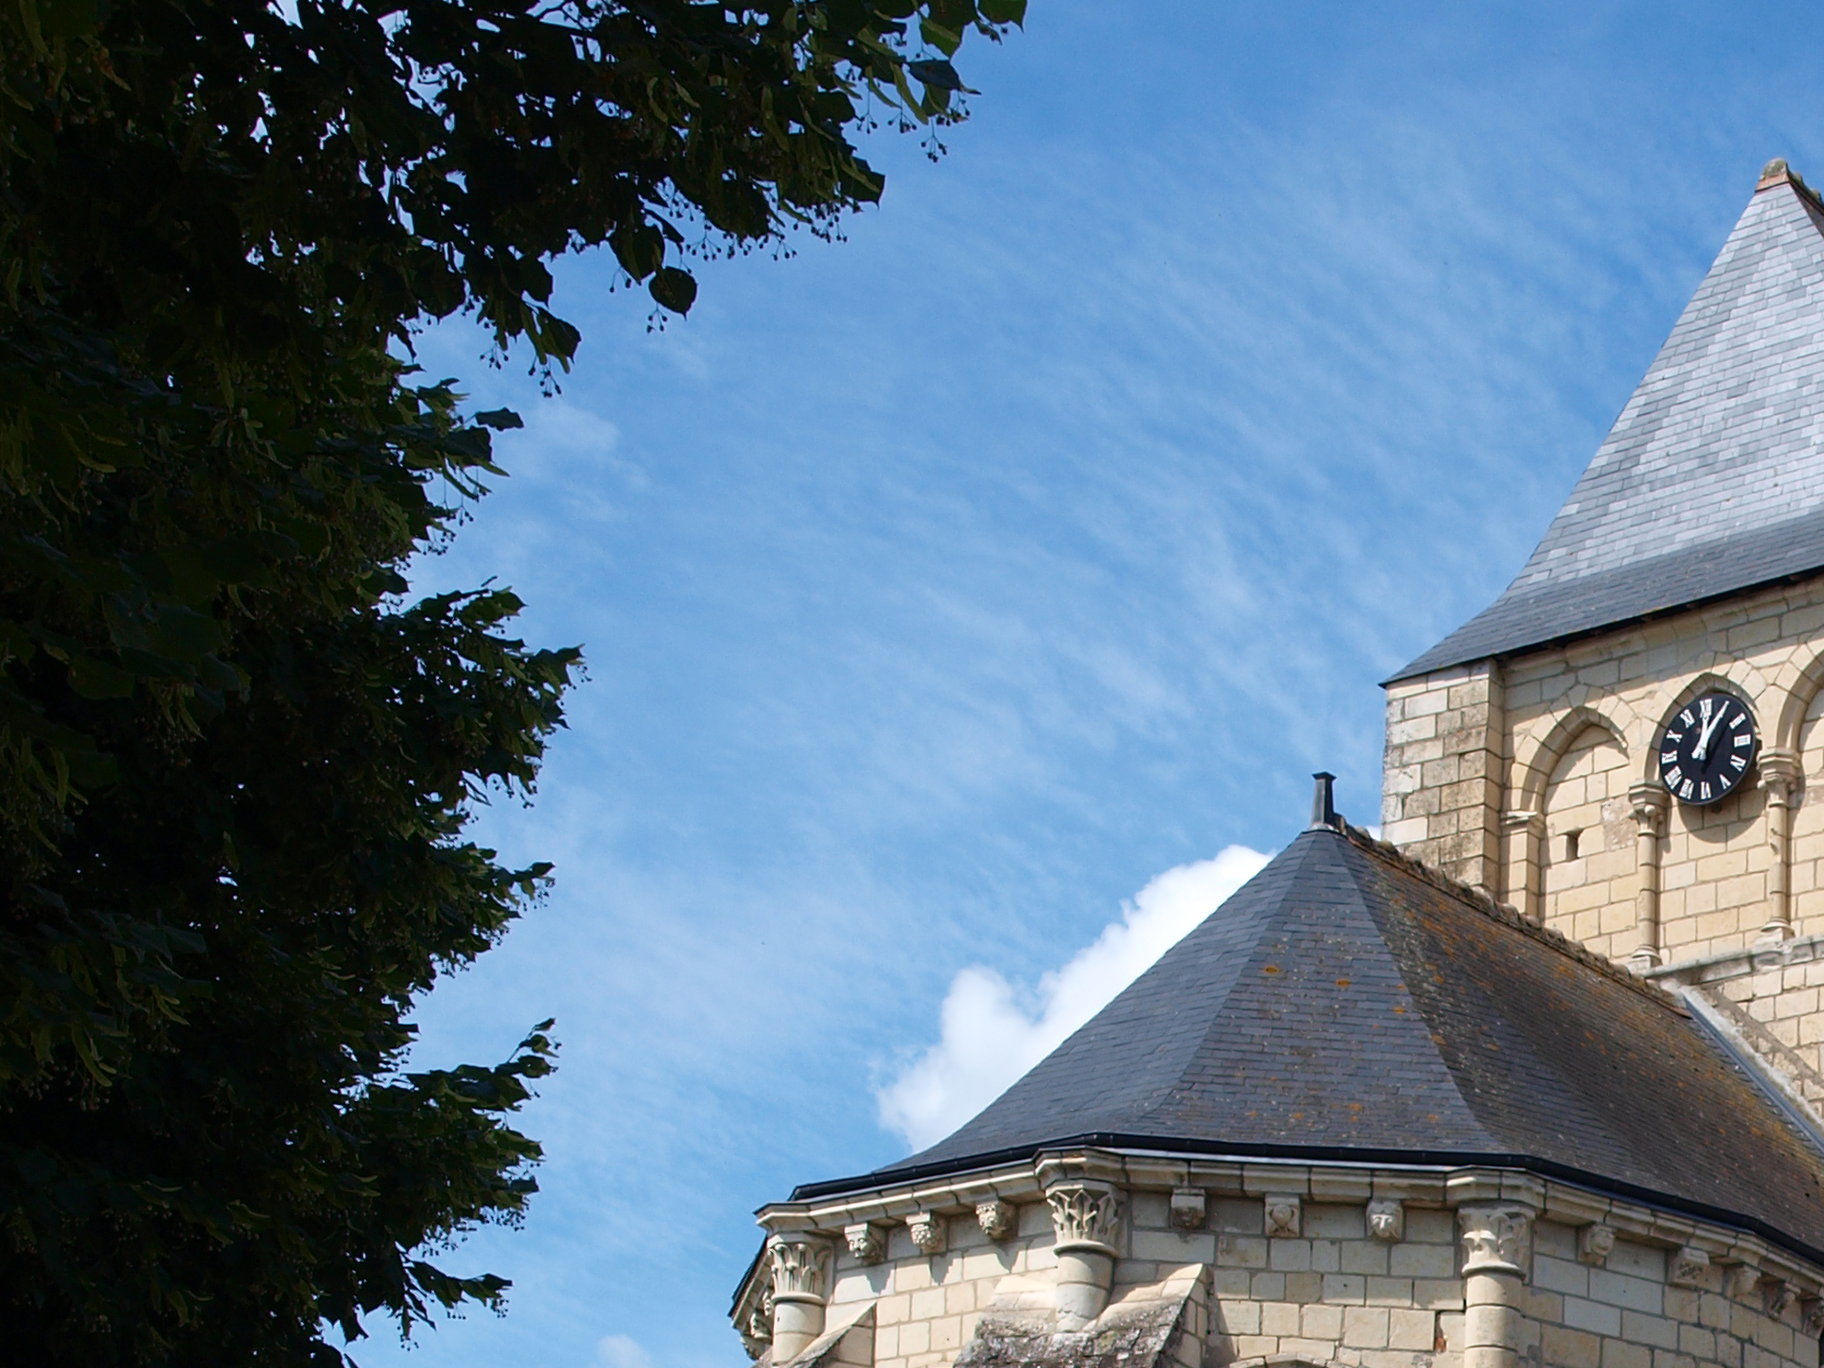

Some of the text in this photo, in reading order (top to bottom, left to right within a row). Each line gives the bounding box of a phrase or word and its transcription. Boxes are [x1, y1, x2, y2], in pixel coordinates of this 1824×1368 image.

[1680, 709, 1695, 728] XI
[1666, 729, 1683, 742] X
[1730, 754, 1747, 772] IV
[1700, 781, 1711, 799] VI
[1719, 774, 1731, 790] V
